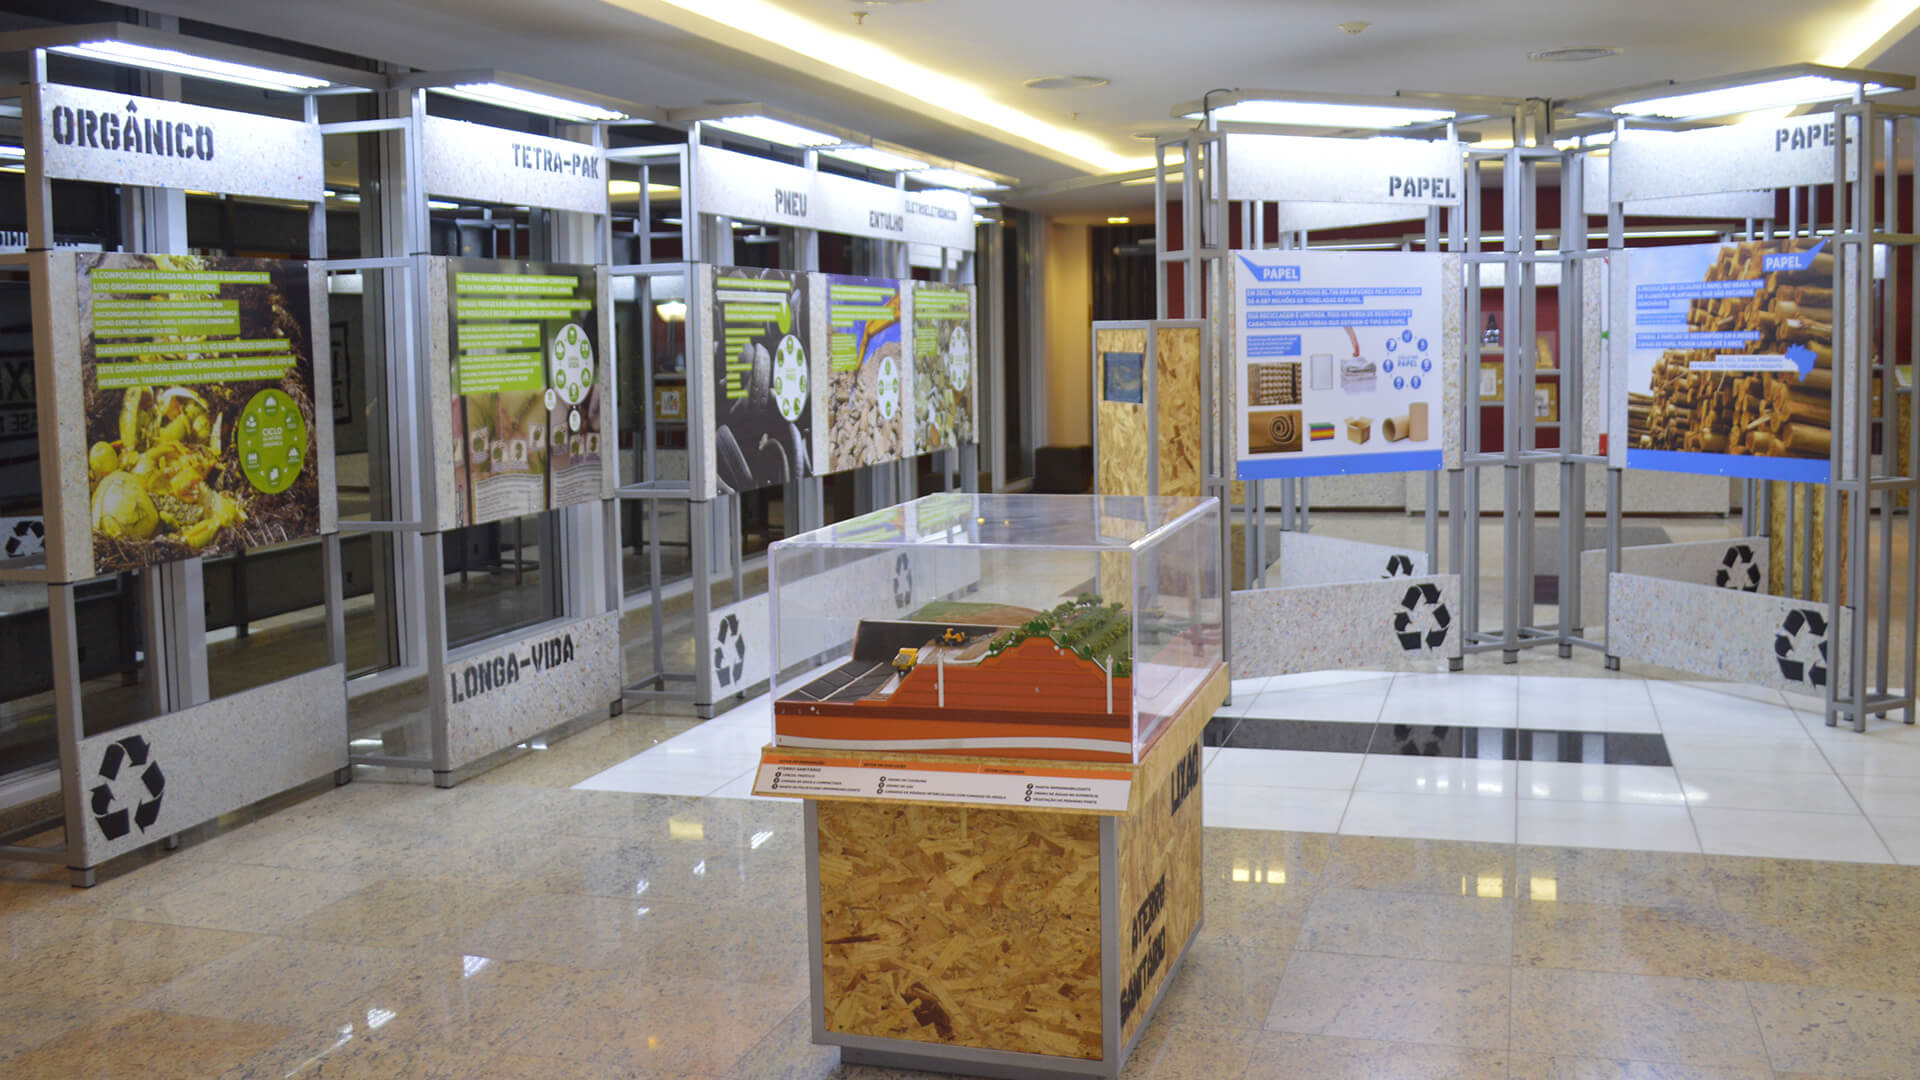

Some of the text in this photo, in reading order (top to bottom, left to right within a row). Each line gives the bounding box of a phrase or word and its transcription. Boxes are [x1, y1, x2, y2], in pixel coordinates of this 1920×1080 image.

[53, 99, 215, 161] ORGÂNICO
[511, 143, 600, 179] TETRA-PAK
[775, 188, 807, 217] PNEU
[1388, 175, 1457, 199] PAPEL
[869, 210, 904, 232] ENTULHO
[1263, 267, 1299, 280] PAPEL
[1765, 255, 1803, 270] PAPEL
[450, 633, 575, 704] LONGA-VIDA
[1171, 741, 1198, 816] LIXÃO
[1131, 873, 1166, 954] ATERRO
[1120, 925, 1166, 1029] SANITÁRIO
